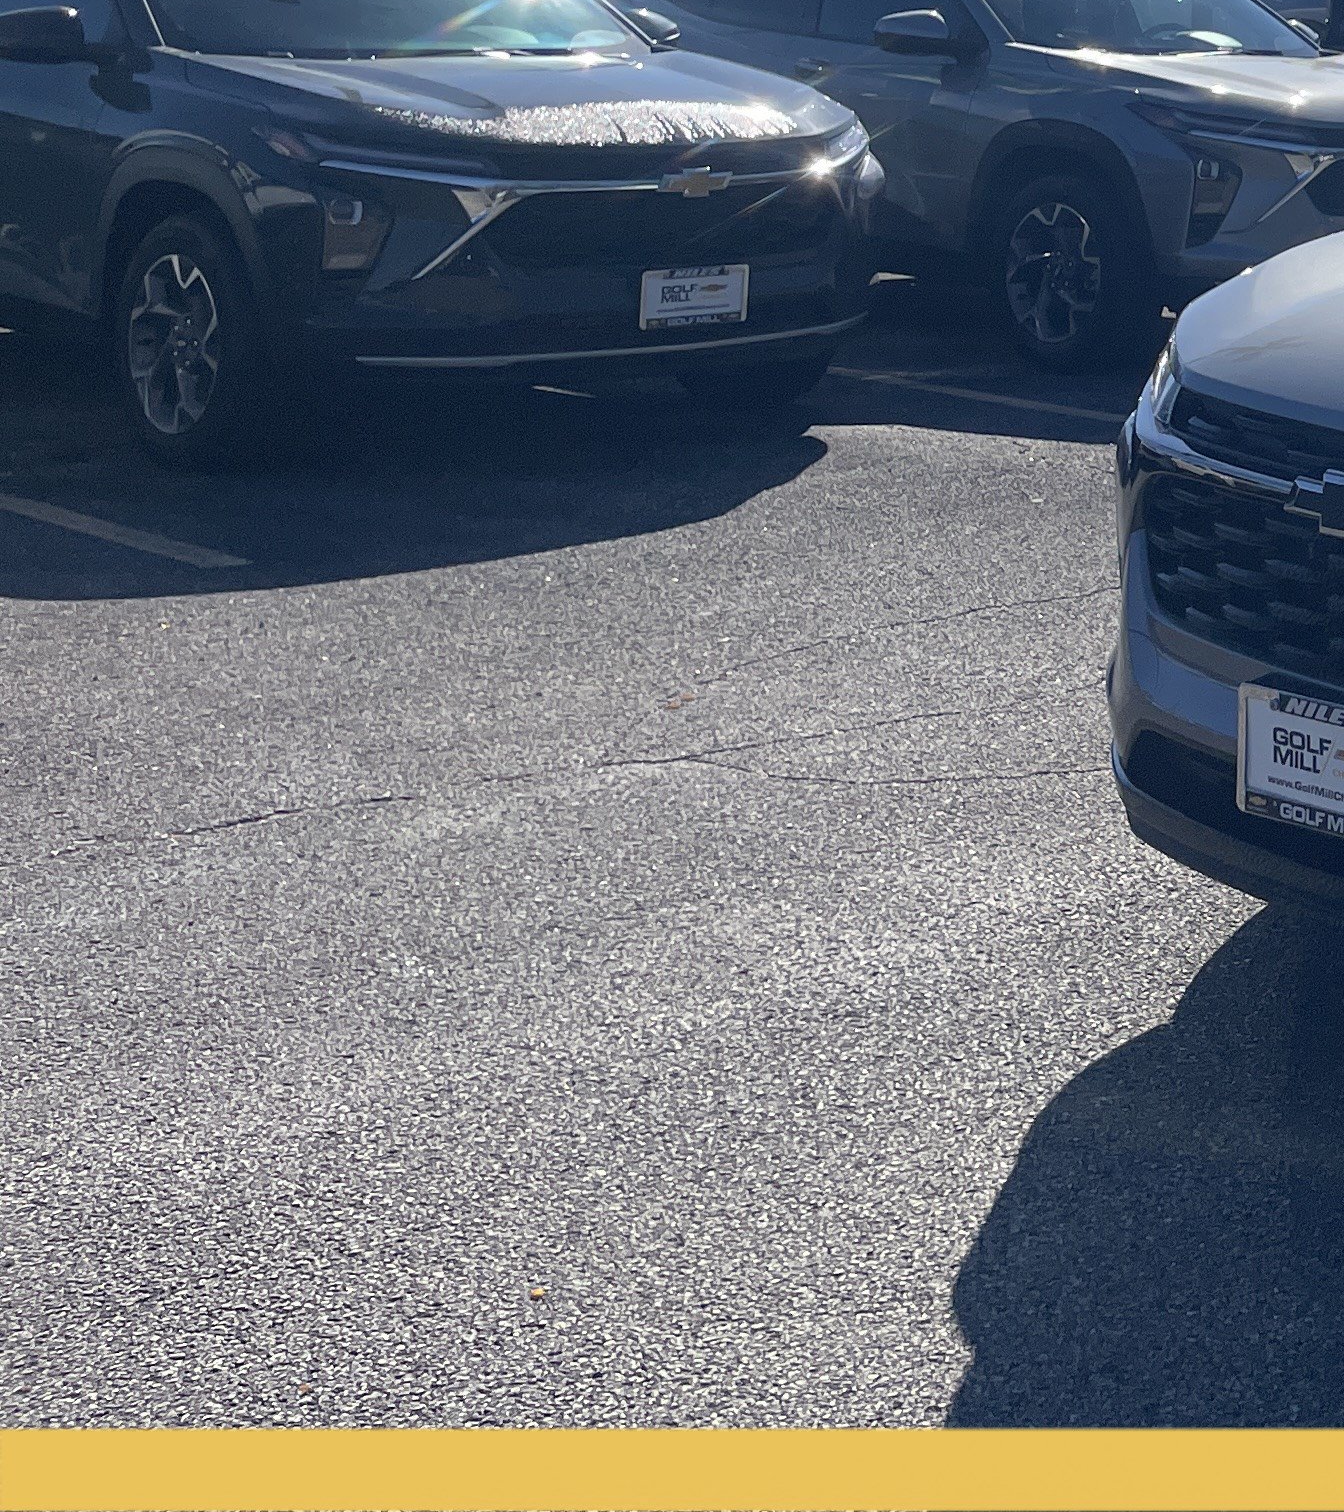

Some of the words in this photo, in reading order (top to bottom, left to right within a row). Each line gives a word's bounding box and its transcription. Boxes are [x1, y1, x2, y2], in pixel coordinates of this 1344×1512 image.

[1272, 727, 1332, 756] GOLF
[1272, 745, 1321, 774] MILL
[1279, 802, 1325, 827] GOLF
